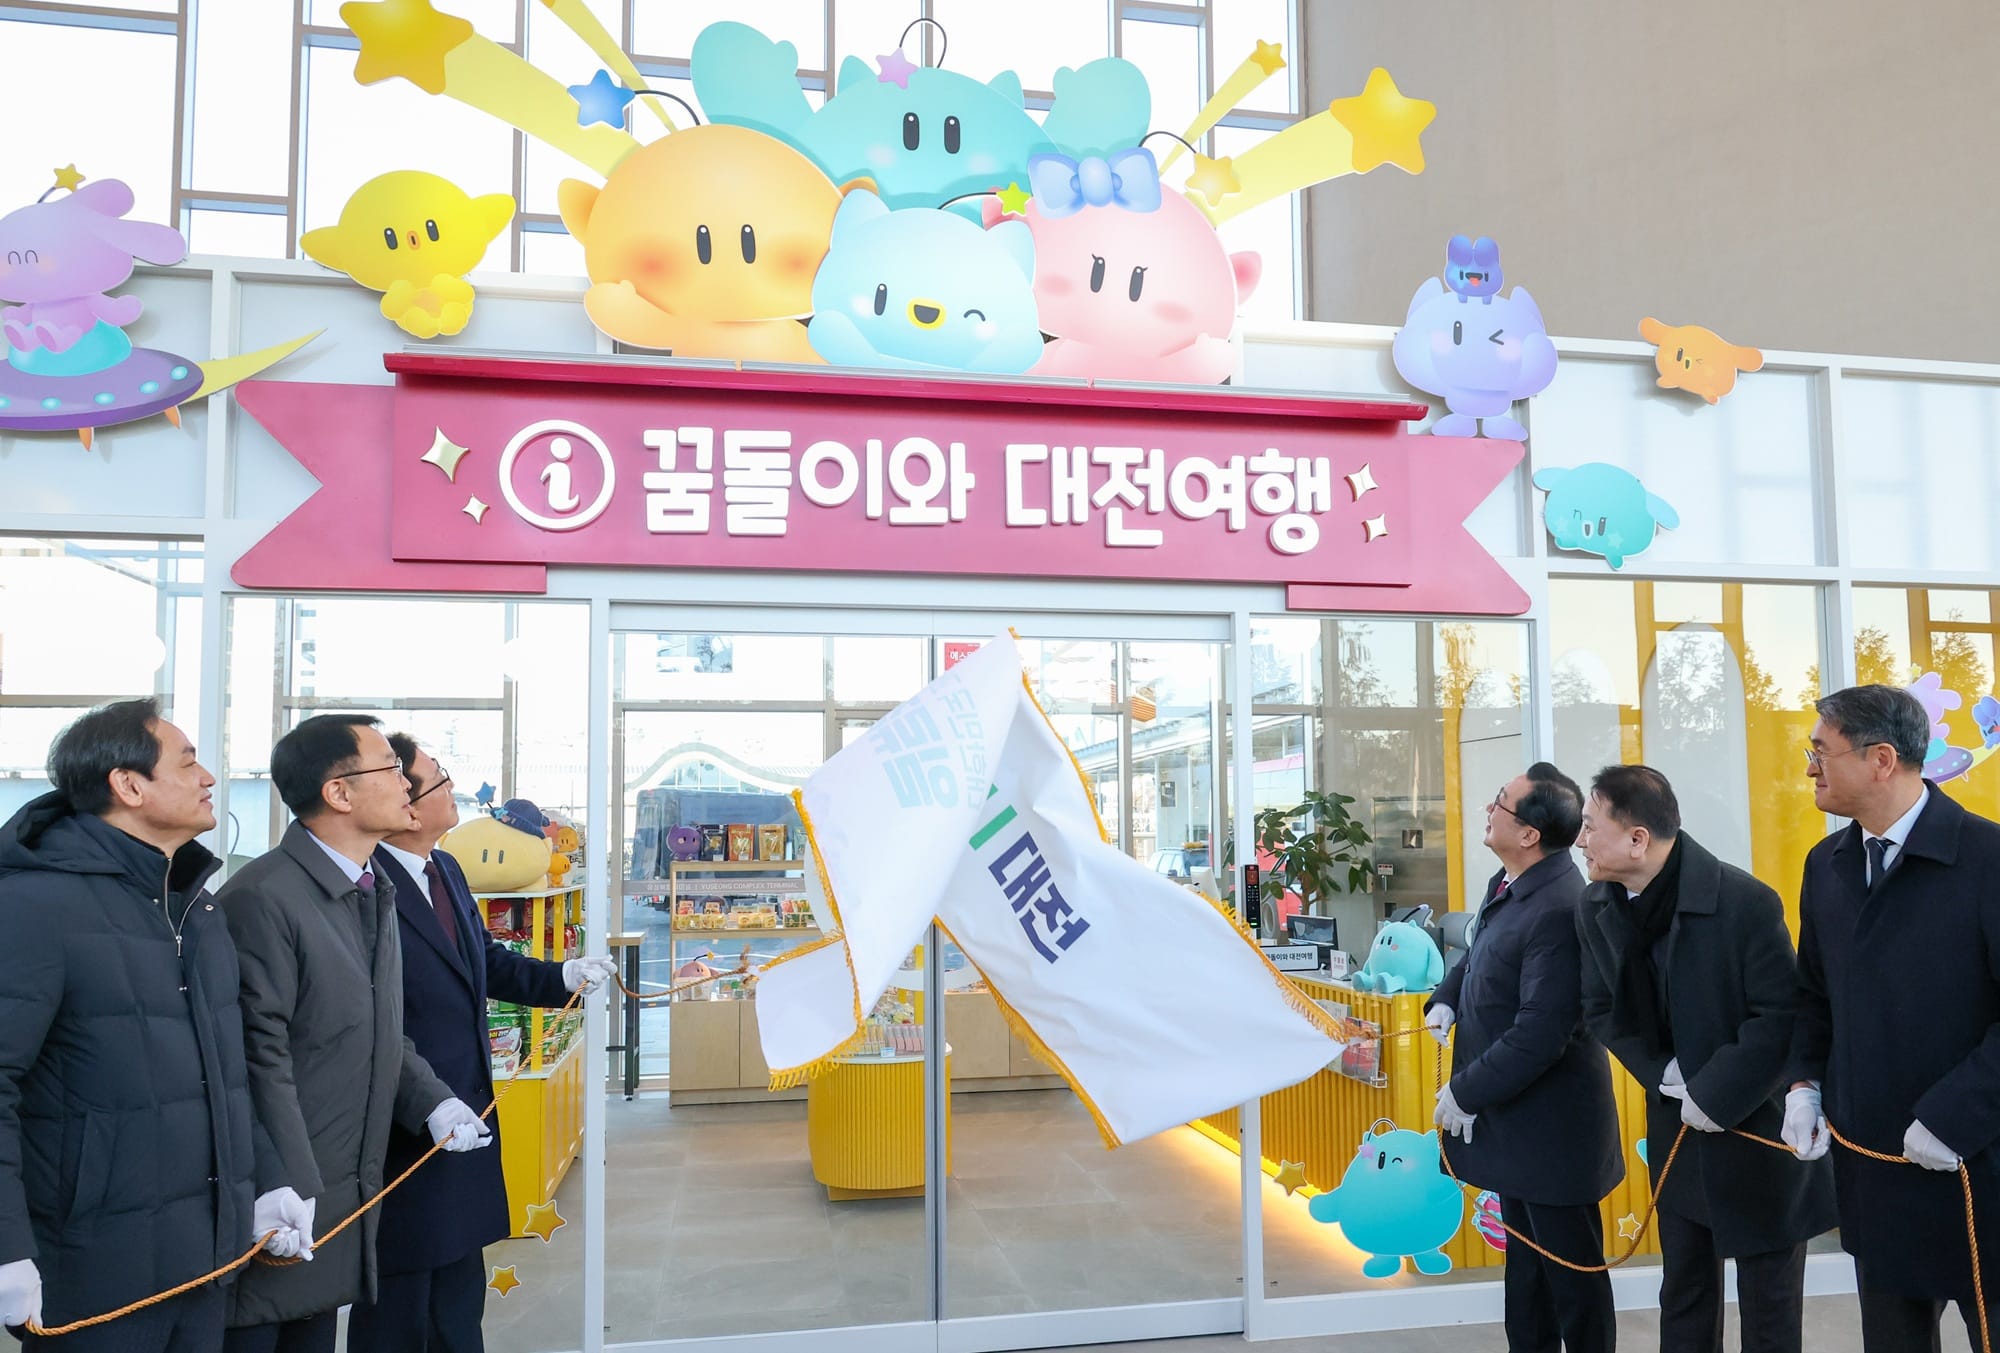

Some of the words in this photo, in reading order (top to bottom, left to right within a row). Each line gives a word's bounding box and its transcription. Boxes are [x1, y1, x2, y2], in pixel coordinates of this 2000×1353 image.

[643, 427, 976, 537] 꿈돌이와
[1004, 444, 1332, 556] 대전여행
[767, 881, 799, 889] TERMINAL
[988, 830, 1091, 964] 대전
